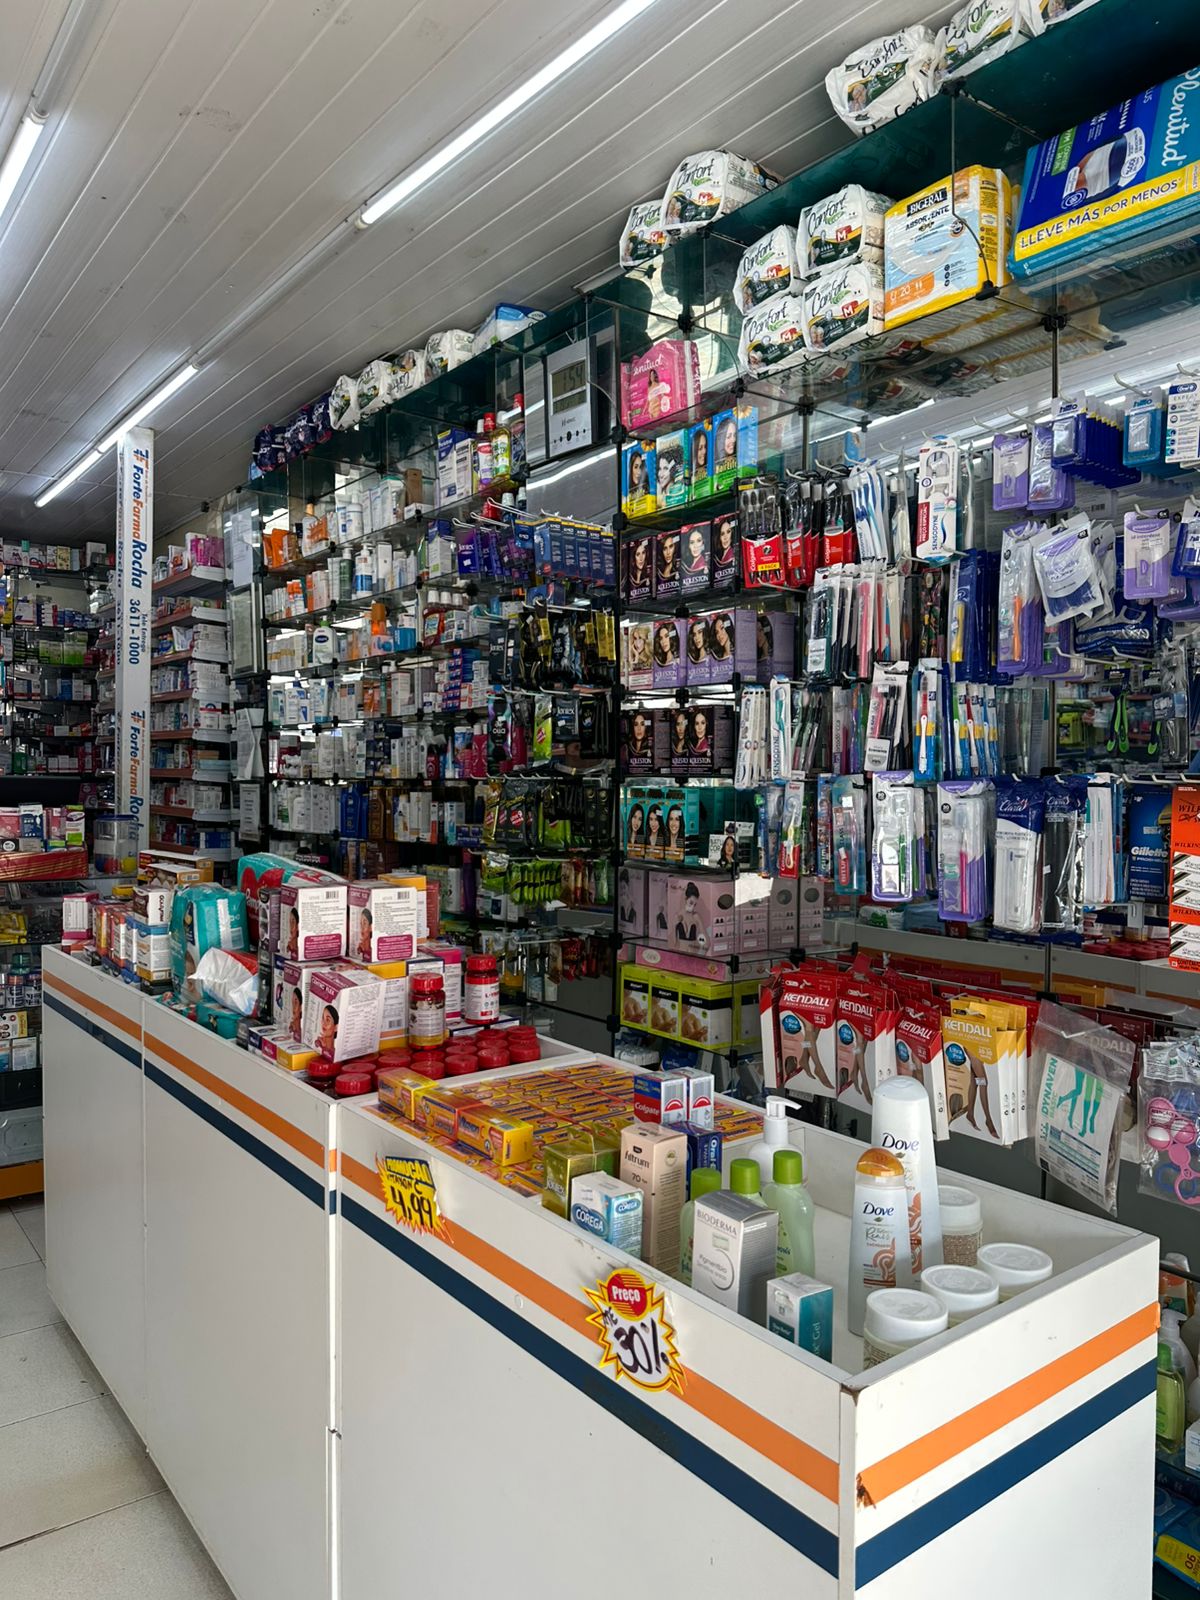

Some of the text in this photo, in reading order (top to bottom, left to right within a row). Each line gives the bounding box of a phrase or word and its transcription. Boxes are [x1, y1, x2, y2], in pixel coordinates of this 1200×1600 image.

[1020, 222, 1063, 249] LLEVE
[1068, 206, 1100, 227] MÁS
[1103, 199, 1128, 216] POR
[837, 231, 848, 242] M
[843, 305, 854, 316] M
[749, 302, 788, 342] Confort
[782, 330, 792, 341] M
[657, 581, 680, 592] KOLESTON
[682, 575, 709, 586] KOLESTON
[128, 599, 139, 665] 3611-1000
[672, 758, 689, 766] KOLESTO
[1131, 846, 1168, 858] Gillette
[784, 993, 829, 1007] KENDALL
[839, 999, 874, 1016] KENDALL
[898, 1020, 932, 1039] KENDALL
[944, 1019, 992, 1038] KENDALL
[1042, 1057, 1058, 1115] DYNAVEN
[634, 1101, 660, 1116] Colgate
[881, 1132, 919, 1151] Dove
[624, 1150, 650, 1169] filtrum
[632, 1172, 641, 1183] 70
[390, 1185, 433, 1229] 4,99
[619, 1201, 638, 1212] COREGA
[863, 1202, 894, 1217] Dove
[576, 1207, 603, 1232] COREGA
[697, 1209, 737, 1236] BIODERMA
[612, 1286, 641, 1305] Preço
